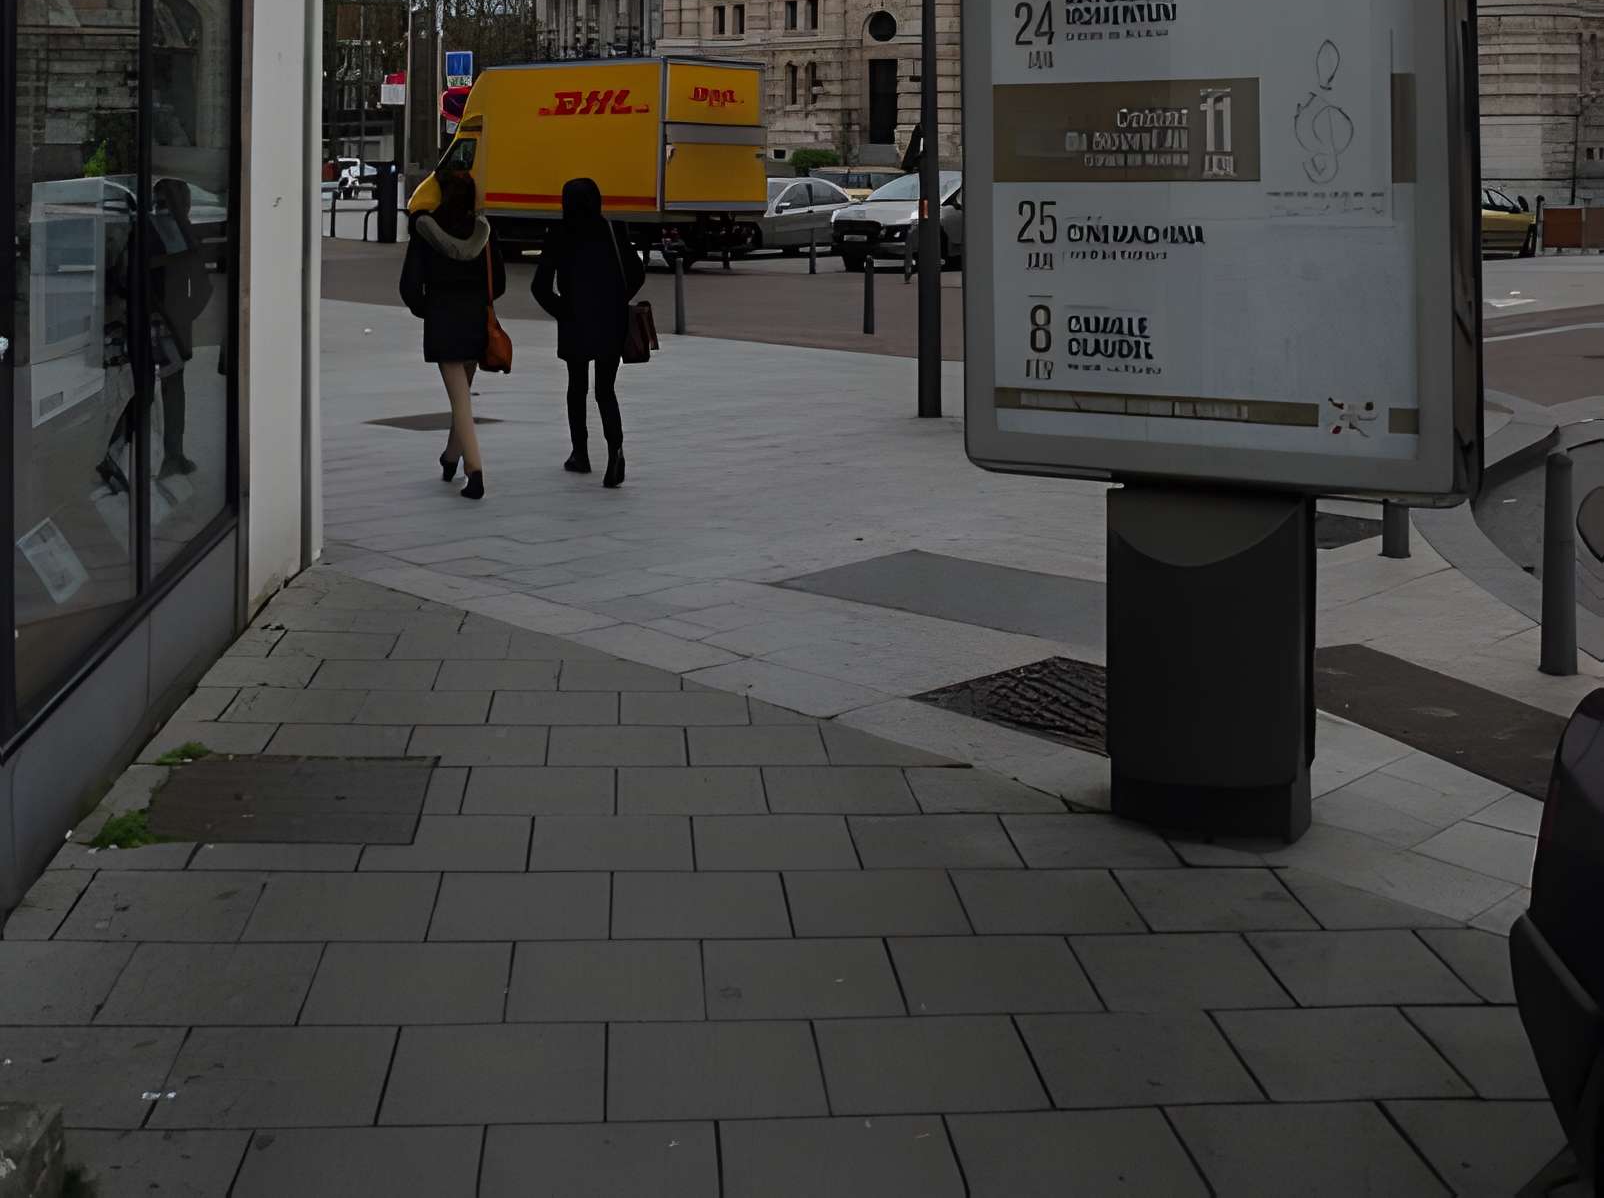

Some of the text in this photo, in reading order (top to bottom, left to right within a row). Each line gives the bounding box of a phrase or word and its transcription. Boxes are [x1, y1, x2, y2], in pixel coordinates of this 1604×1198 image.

[1014, 0, 1055, 45] 24
[554, 89, 633, 115] DHL
[1017, 200, 1057, 244] 25
[1030, 304, 1052, 353] 8
